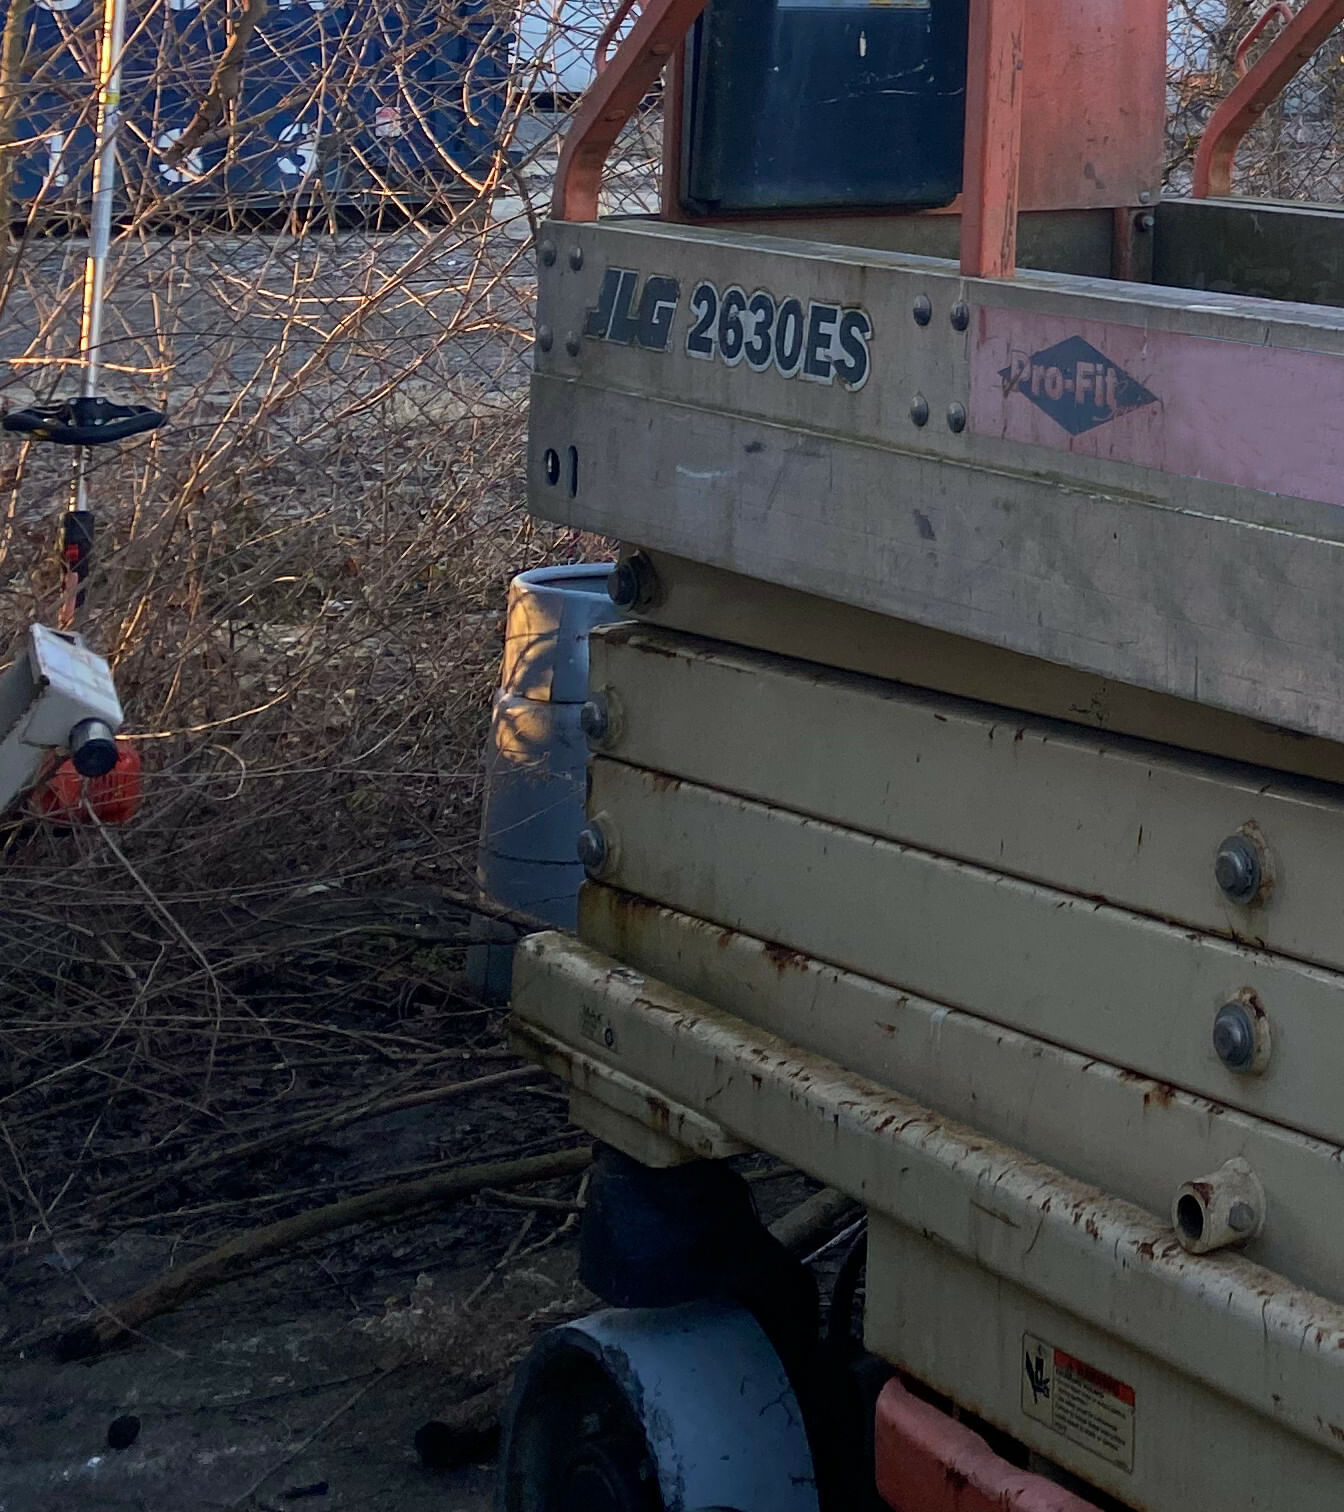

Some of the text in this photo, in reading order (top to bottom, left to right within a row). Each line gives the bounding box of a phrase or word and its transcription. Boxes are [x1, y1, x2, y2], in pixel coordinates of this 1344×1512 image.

[584, 268, 874, 392] JLG 2630ES
[1007, 349, 1119, 408] Pro-Fit
